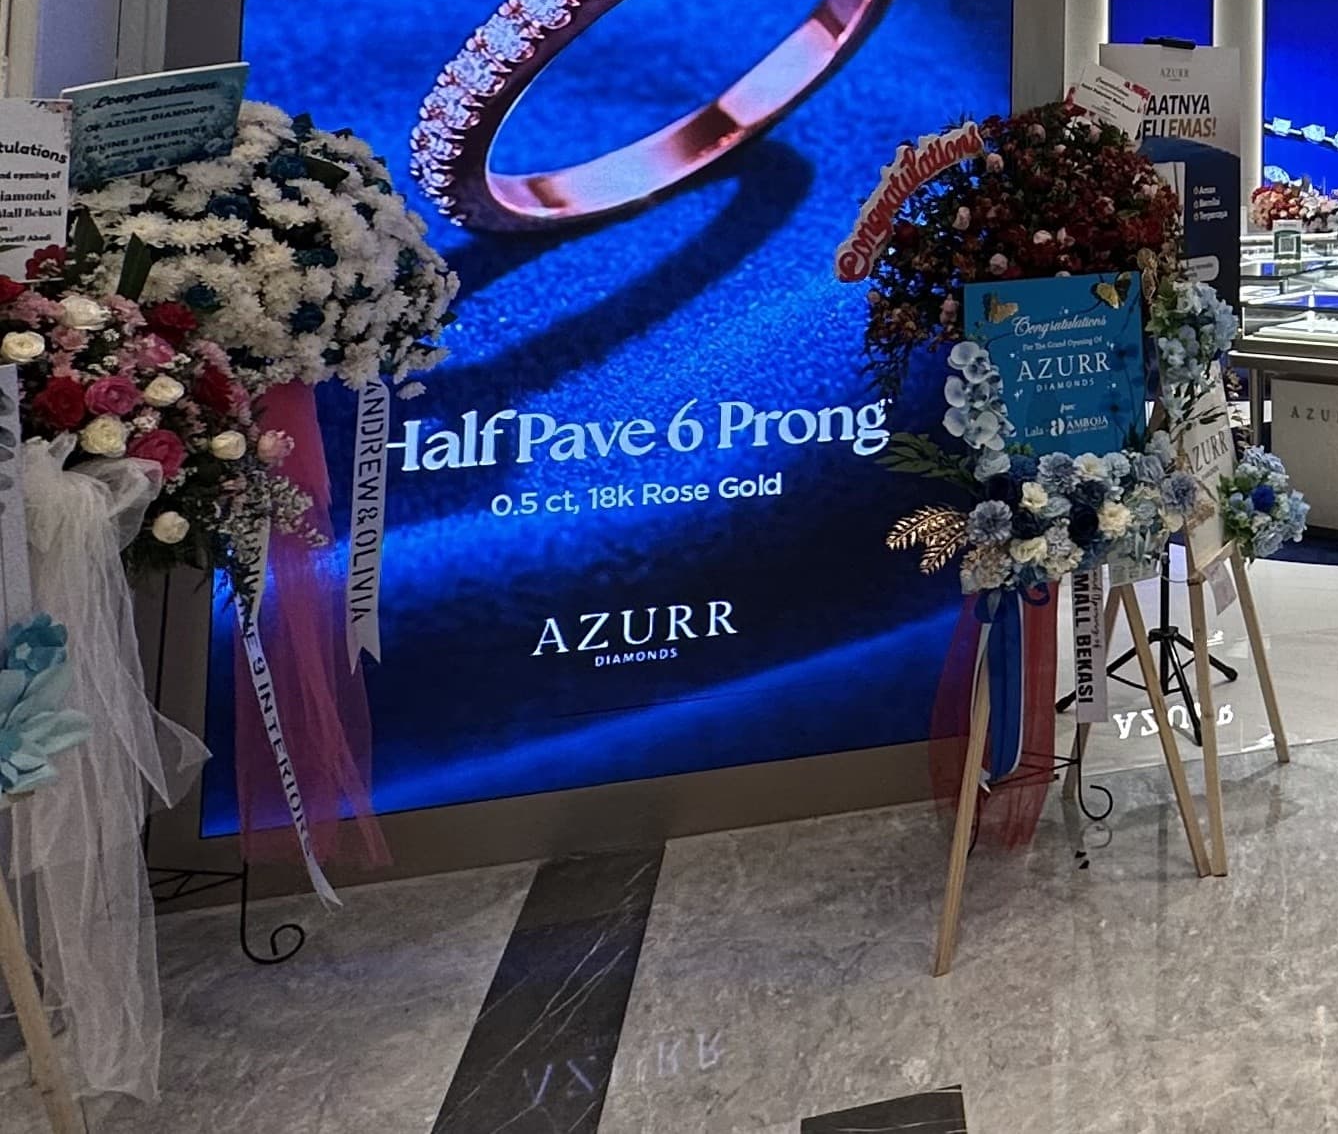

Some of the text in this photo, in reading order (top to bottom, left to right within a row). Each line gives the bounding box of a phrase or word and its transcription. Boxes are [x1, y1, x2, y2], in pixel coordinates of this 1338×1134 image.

[105, 116, 148, 129] AZURR
[151, 105, 216, 121] DIAMONDS
[1144, 94, 1210, 116] AATNYA
[1168, 116, 1217, 139] EMAS!
[0, 141, 68, 164] tulations
[51, 170, 61, 179] of
[0, 189, 56, 202] iamonds
[838, 124, 983, 283] Congratulations
[24, 207, 62, 217] Bekasi
[1012, 314, 1107, 339] Congratulations
[1016, 352, 1111, 382] AZURR
[1036, 378, 1095, 393] DIAMONDS
[385, 398, 893, 472] Half Pave 6 Prong
[350, 380, 385, 623] ANDREW & OLIVIA
[490, 472, 783, 517] 0.5 ct, 18k Rose Gold
[529, 600, 739, 657] AZURR
[1073, 573, 1094, 704] MALL BEKASI
[594, 646, 679, 667] DIAMONDS
